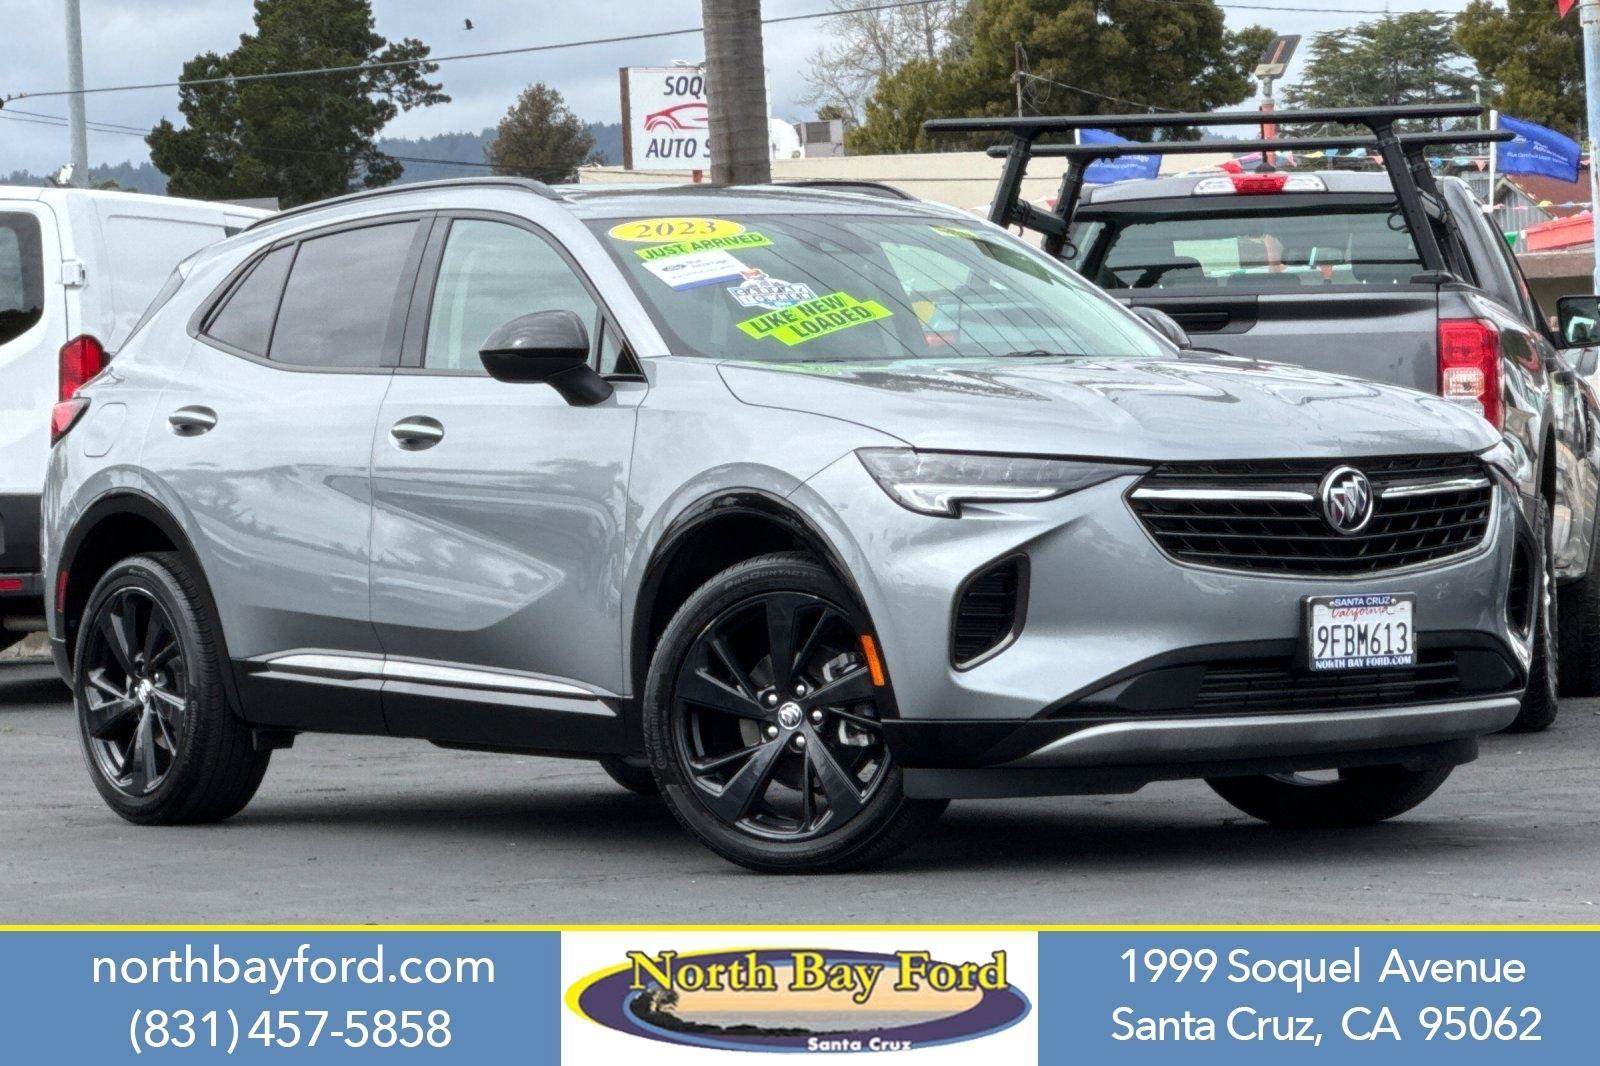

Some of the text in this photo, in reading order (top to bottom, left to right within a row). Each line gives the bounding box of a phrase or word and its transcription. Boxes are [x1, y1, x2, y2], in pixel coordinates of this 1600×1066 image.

[663, 76, 707, 99] SOQ
[646, 138, 697, 158] AUTO
[634, 221, 718, 238] 2023
[643, 233, 763, 259] JUST ARRIVED
[749, 308, 799, 334] LIKE
[801, 294, 846, 317] NEW
[788, 304, 874, 338] LOADED
[1334, 597, 1391, 607] SANTA CRUZ
[1317, 622, 1408, 658] 9FBM613
[1315, 655, 1412, 669] NORTH BAY FORD.COM
